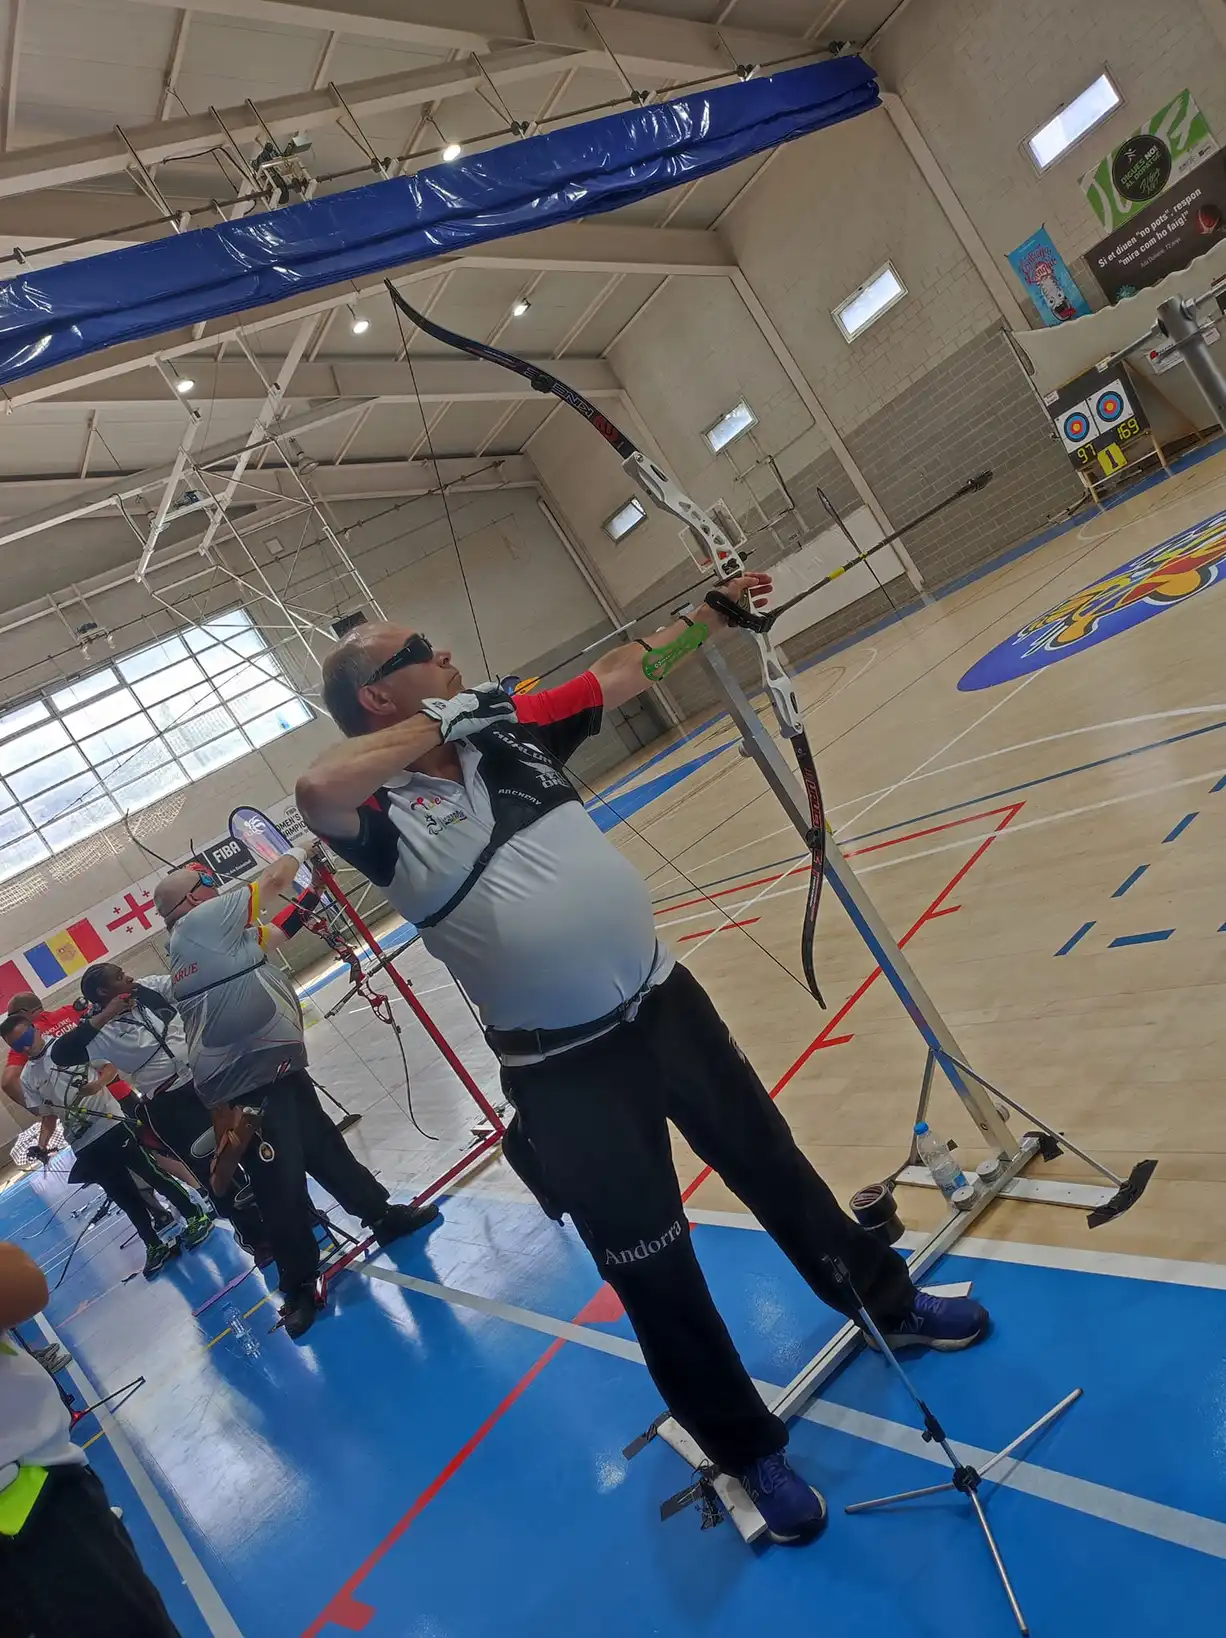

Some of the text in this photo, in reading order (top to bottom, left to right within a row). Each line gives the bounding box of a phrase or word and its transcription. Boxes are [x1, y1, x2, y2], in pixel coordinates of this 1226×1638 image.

[1144, 145, 1158, 160] NO!
[1098, 256, 1107, 268] Si
[1107, 251, 1117, 262] et
[1115, 236, 1137, 256] diuen
[1173, 188, 1202, 213] respon
[1139, 238, 1157, 253] com
[1157, 229, 1168, 241] ho
[1077, 416, 1140, 464] 97 169
[1104, 448, 1119, 470] 1
[498, 788, 543, 806] ARCHERY
[276, 813, 302, 831] OMEN'S
[284, 820, 308, 837] AMPIO
[212, 841, 241, 863] FIBA
[55, 1022, 78, 1039] GIUM
[605, 1220, 682, 1265] Andorra
